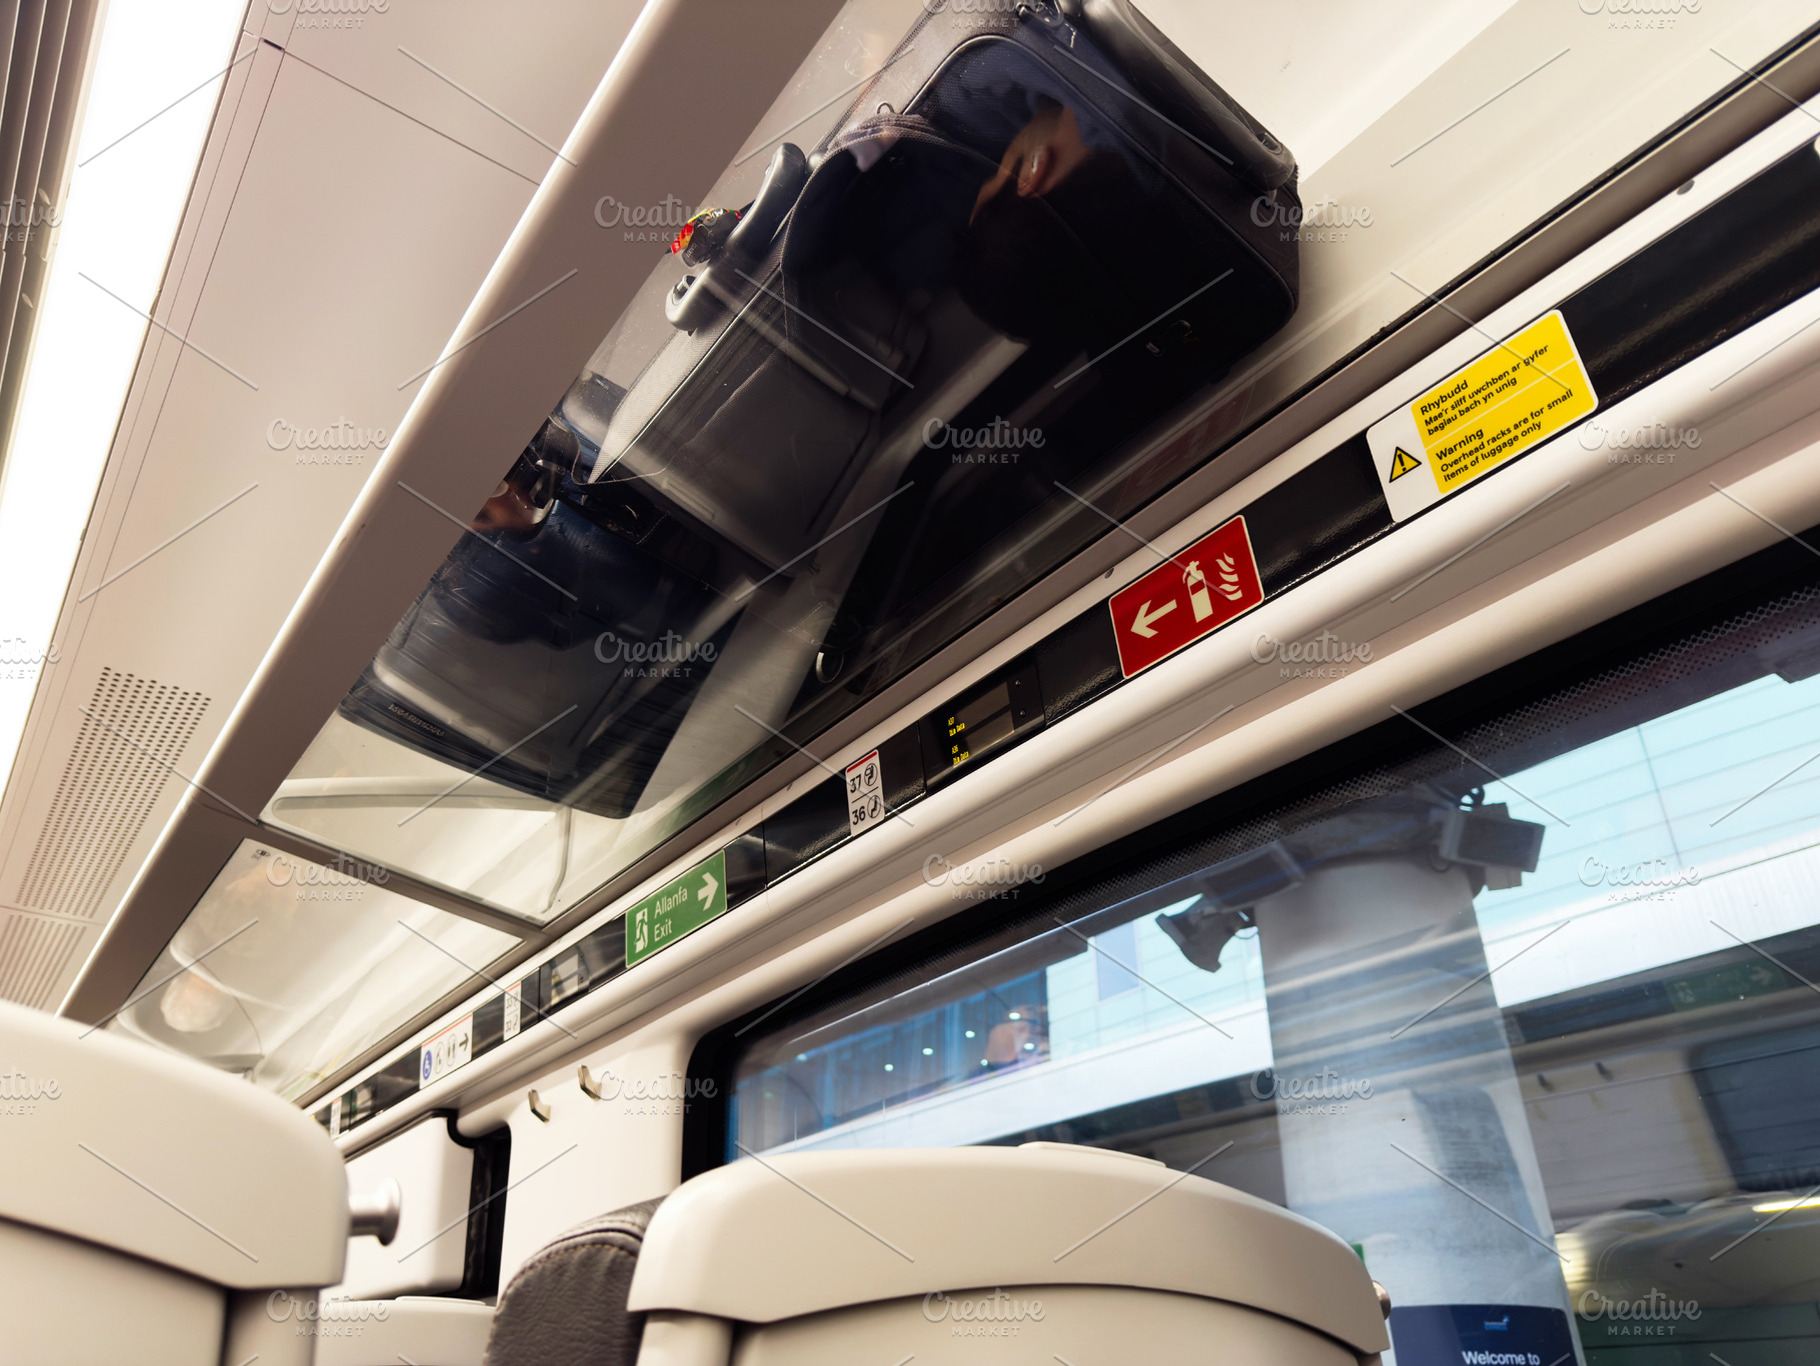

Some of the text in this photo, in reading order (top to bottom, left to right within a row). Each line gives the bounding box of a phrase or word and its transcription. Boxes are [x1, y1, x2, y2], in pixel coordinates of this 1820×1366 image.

[1420, 380, 1468, 415] Rhybudd
[1424, 345, 1549, 427] Mae'r silff uwchben ar gyfer
[1458, 399, 1481, 417] bach
[1481, 392, 1494, 404] yn
[1495, 377, 1517, 394] unig
[1435, 429, 1484, 461] Warning
[1440, 389, 1574, 472] Overhead racks are for small
[1470, 455, 1480, 467] of
[1481, 435, 1519, 460] luggage
[1521, 421, 1542, 437] only
[850, 774, 861, 793] 37
[852, 806, 866, 825] 36
[654, 886, 688, 919] Allanfa
[654, 918, 672, 942] Exit
[1461, 1350, 1540, 1365] Welcome to
